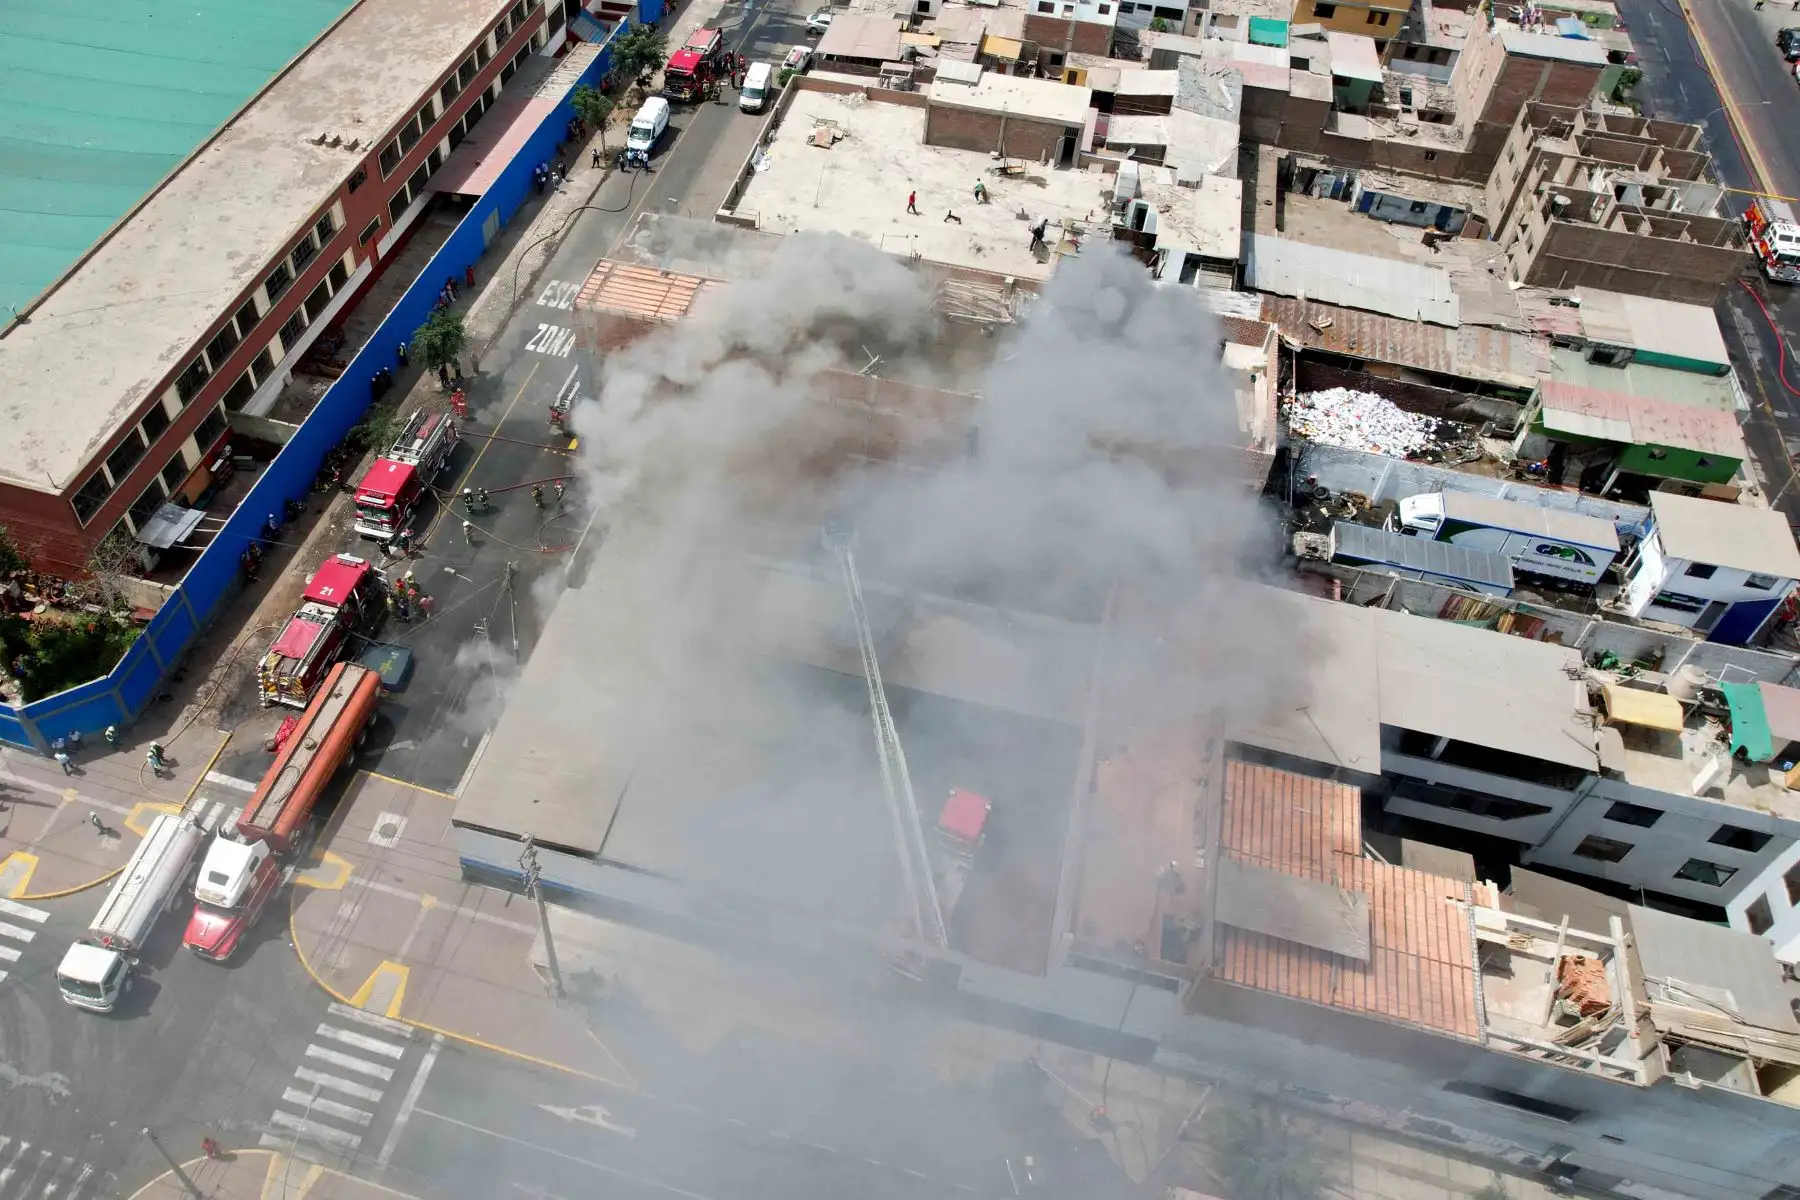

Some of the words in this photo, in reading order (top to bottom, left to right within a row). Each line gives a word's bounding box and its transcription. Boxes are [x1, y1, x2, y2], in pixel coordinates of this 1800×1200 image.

[536, 279, 581, 311] ESC
[524, 323, 576, 358] ZONA
[320, 586, 334, 597] 21
